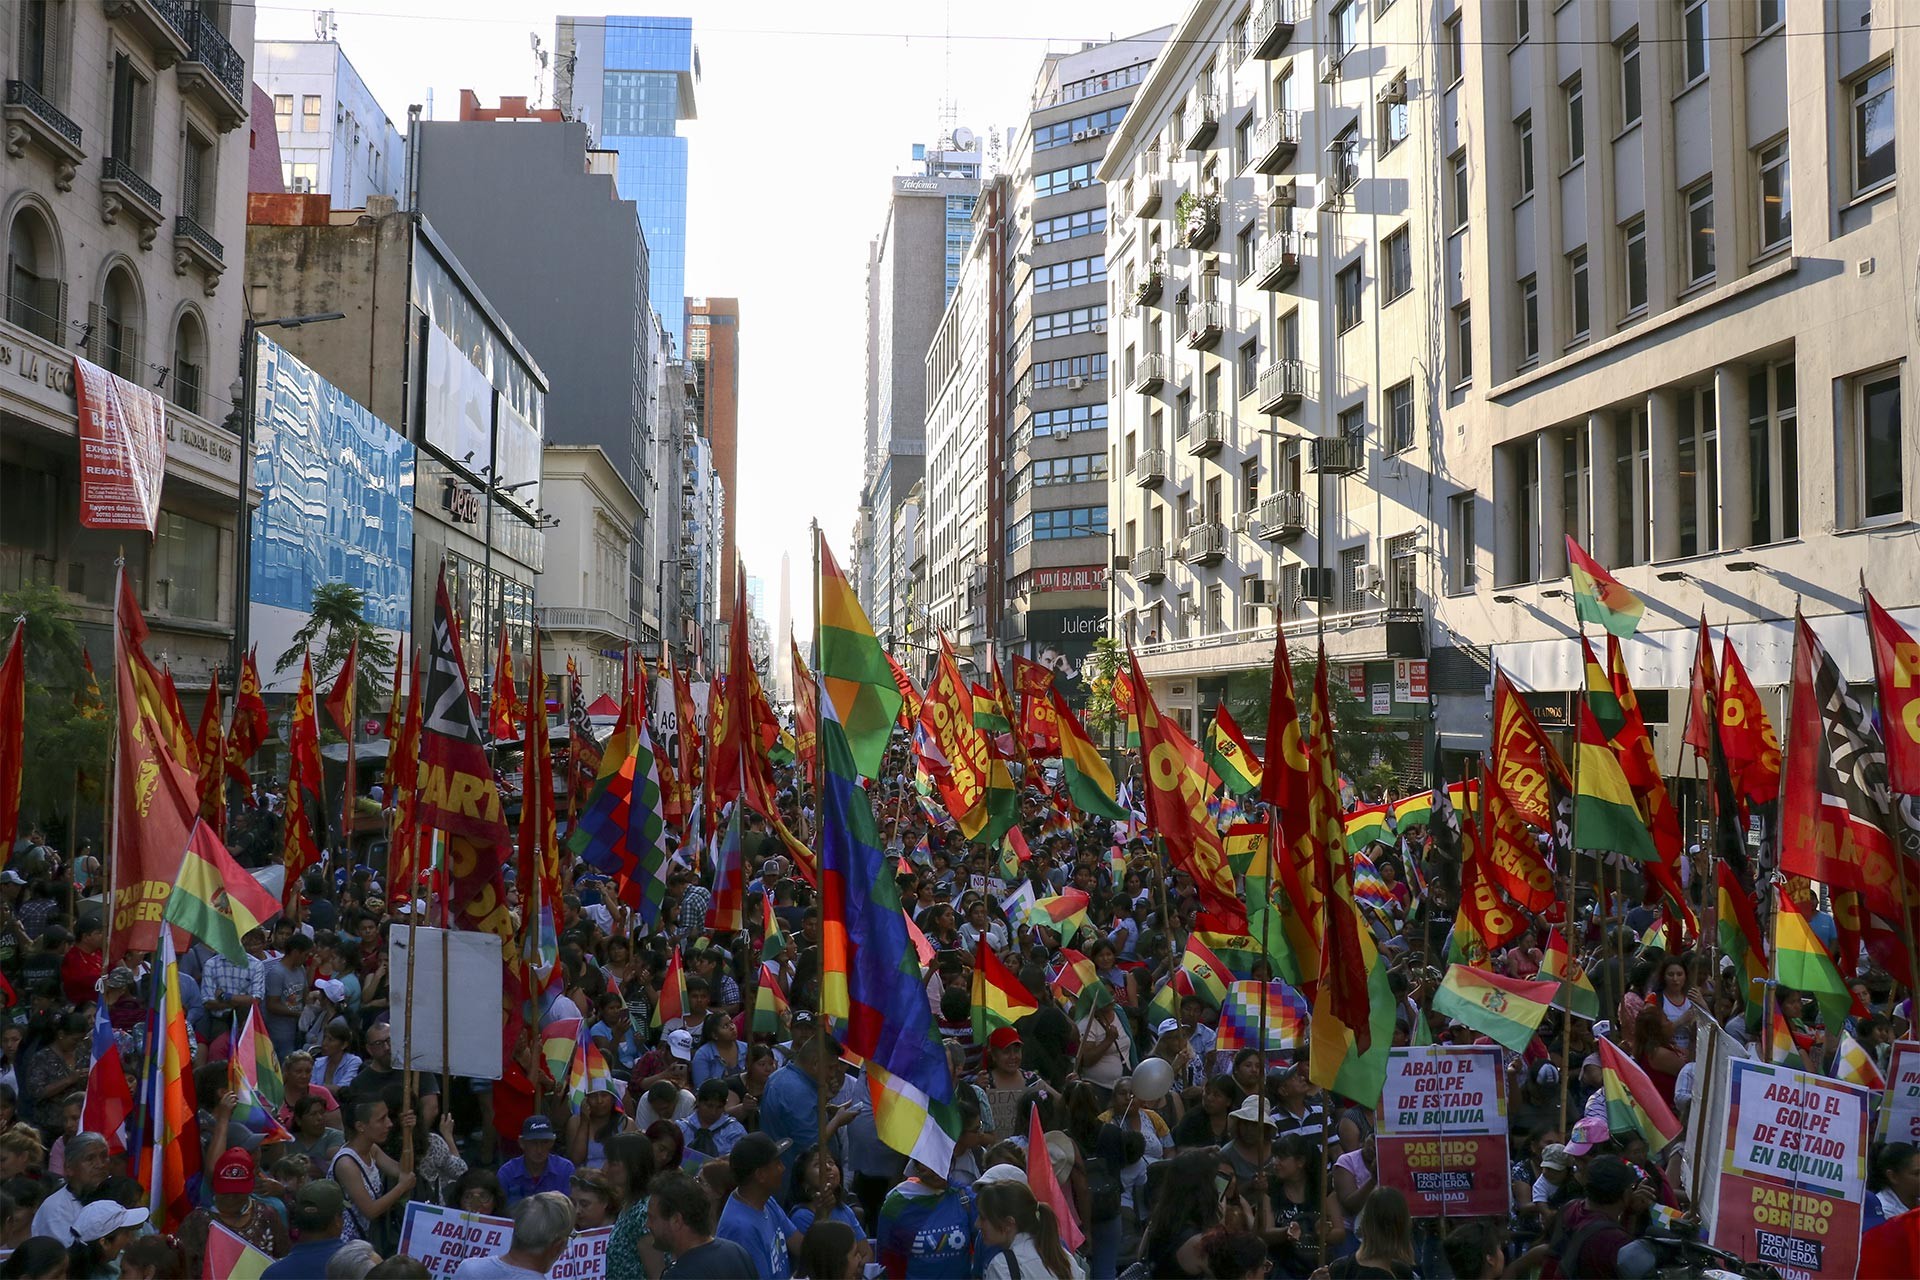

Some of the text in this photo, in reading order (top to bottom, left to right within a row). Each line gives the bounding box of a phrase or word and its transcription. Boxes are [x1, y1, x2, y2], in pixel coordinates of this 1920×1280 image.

[20, 350, 38, 382] LA
[1061, 615, 1108, 634] Juleria
[1402, 1060, 1474, 1076] ABAJO EL
[1414, 1076, 1465, 1092] GOLPE
[1398, 1092, 1484, 1109] DE ESTADO
[1763, 1083, 1840, 1116] ABAJO EL
[1398, 1109, 1484, 1125] EN BOLIVIA
[1775, 1107, 1831, 1134] GOLPE
[1404, 1141, 1479, 1155] PARTIDO
[1752, 1123, 1845, 1160] DE ESTADO
[1407, 1153, 1477, 1168] OBRERO
[1749, 1145, 1843, 1182] EN BOLIVIA
[1417, 1172, 1455, 1181] FRENTE
[1417, 1180, 1471, 1189] IZQUIERDA
[1424, 1192, 1465, 1202] UNIDAD
[1751, 1186, 1833, 1217] PARTIDO
[1753, 1205, 1829, 1235] OBRERO
[432, 1221, 502, 1247] ABAJO EL
[1761, 1232, 1816, 1254] FRENTE DE
[439, 1240, 491, 1259] GOLPE
[560, 1243, 593, 1261] AJO
[1760, 1244, 1819, 1265] IZQUIERDA
[421, 1254, 440, 1271] DE
[552, 1258, 601, 1279] GOLPE
[1774, 1265, 1811, 1280] NIDAD
